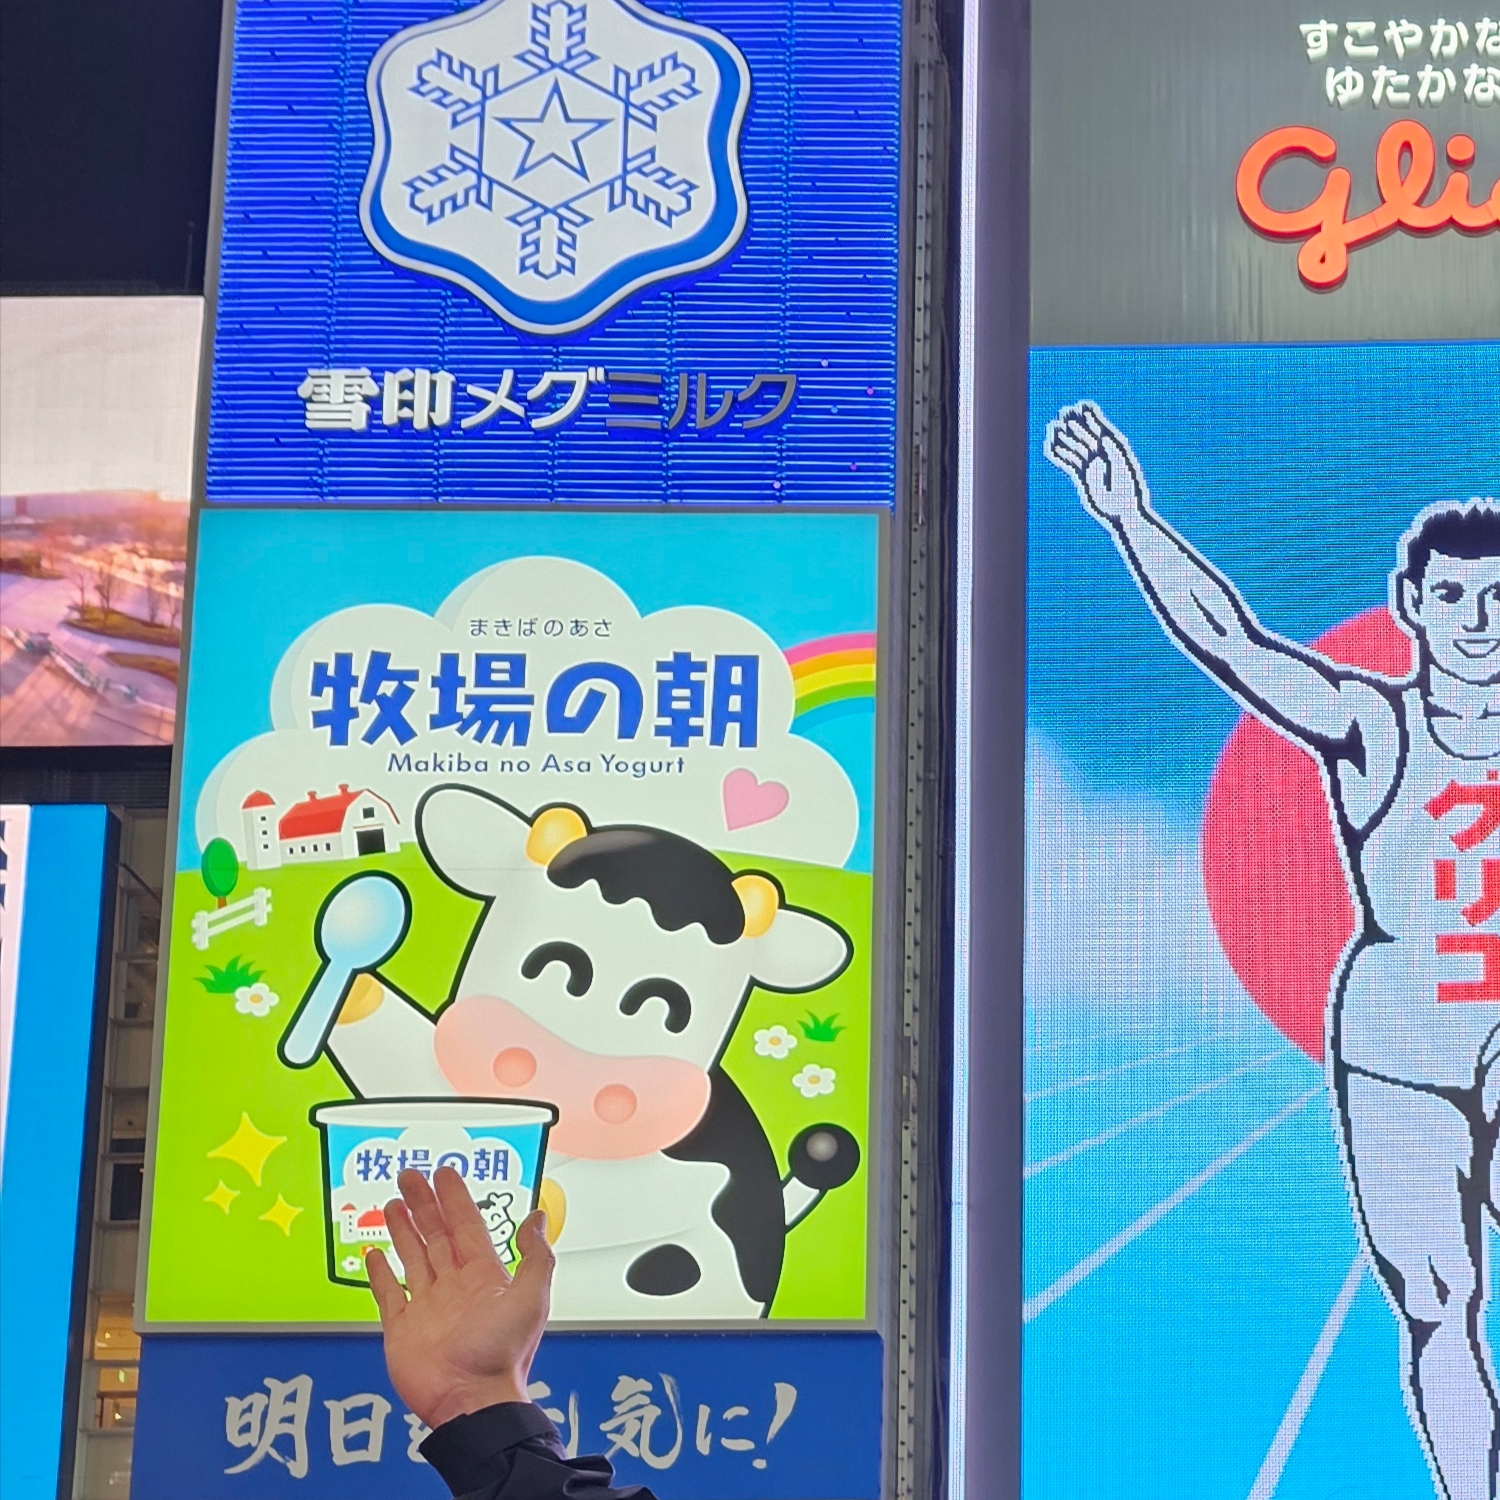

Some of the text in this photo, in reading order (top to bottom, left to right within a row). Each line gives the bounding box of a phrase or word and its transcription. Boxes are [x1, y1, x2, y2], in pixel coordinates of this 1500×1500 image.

[297, 366, 798, 431] 雪印メグミルク
[467, 616, 613, 639] まきばのあさ
[309, 650, 760, 749] 牧場の朝
[387, 751, 685, 780] Makiba no Asa Yogurt
